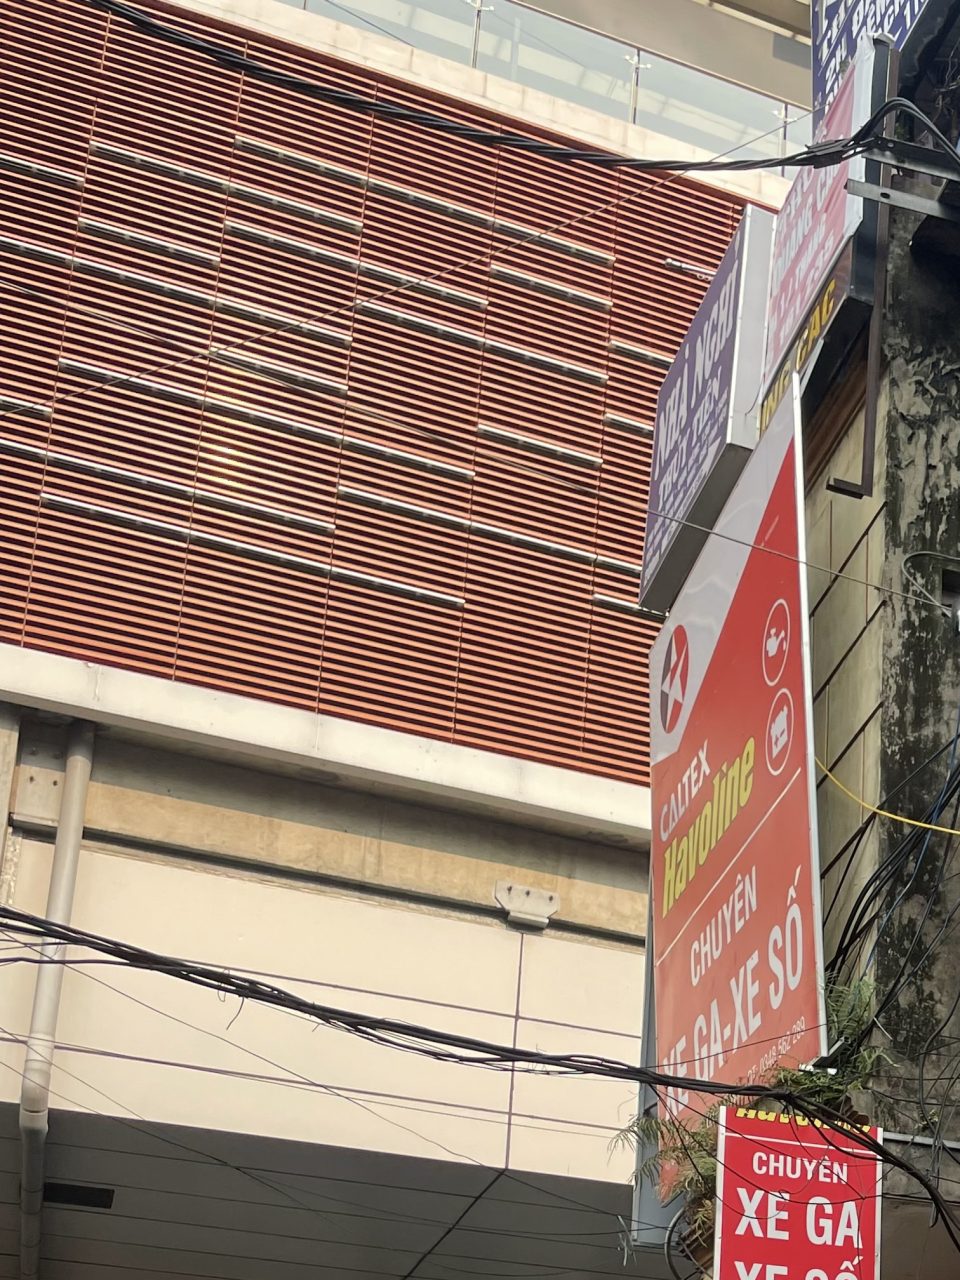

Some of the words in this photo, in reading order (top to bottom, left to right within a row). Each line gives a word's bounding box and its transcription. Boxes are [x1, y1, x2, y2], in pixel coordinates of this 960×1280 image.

[660, 739, 711, 842] CALTEX
[662, 736, 755, 918] Havoline
[690, 865, 757, 987] CHUYÊN
[768, 864, 803, 1010] SỐ
[735, 1187, 790, 1241] XE
[806, 1195, 864, 1249] GA
[752, 1151, 848, 1185] CHUYÊN
